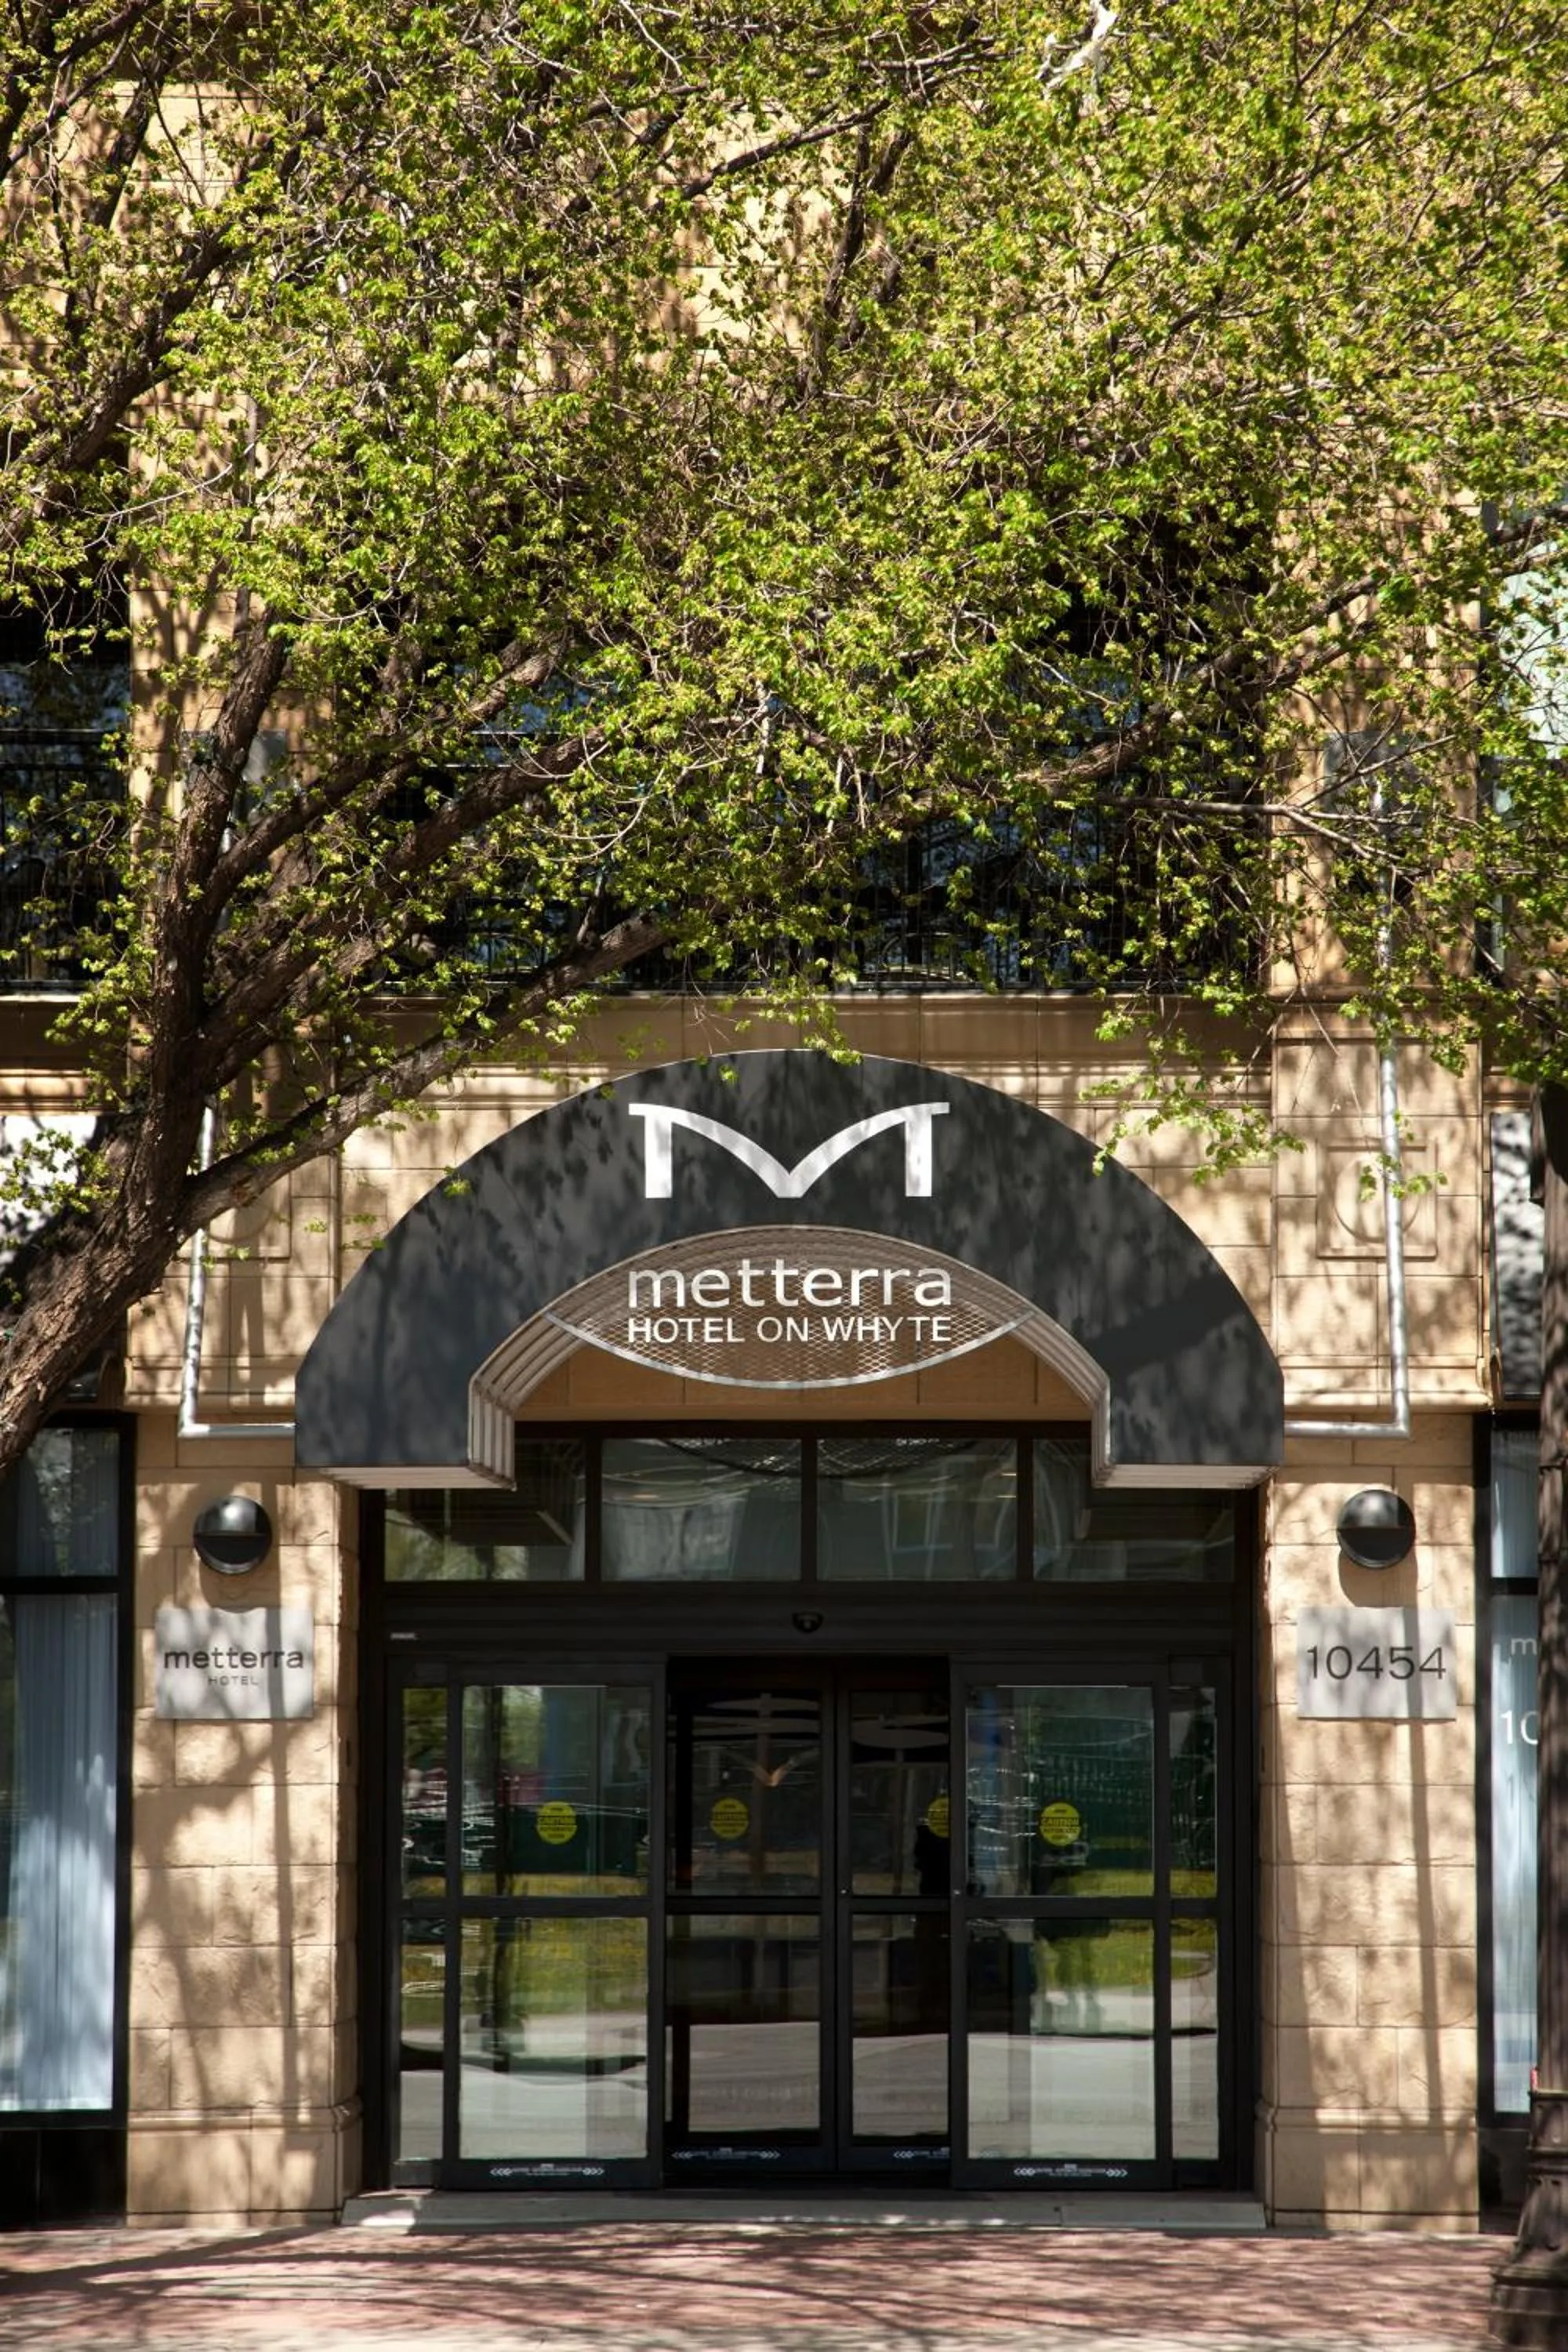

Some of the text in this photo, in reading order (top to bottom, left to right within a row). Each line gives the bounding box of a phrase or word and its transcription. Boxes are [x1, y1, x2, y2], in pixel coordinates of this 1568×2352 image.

[628, 1259, 951, 1308] metterra
[628, 1316, 951, 1342] HOTEL ON WHYTE
[164, 1647, 304, 1669] metterra
[1307, 1646, 1446, 1680] 10454
[208, 1675, 259, 1686] HOTEL
